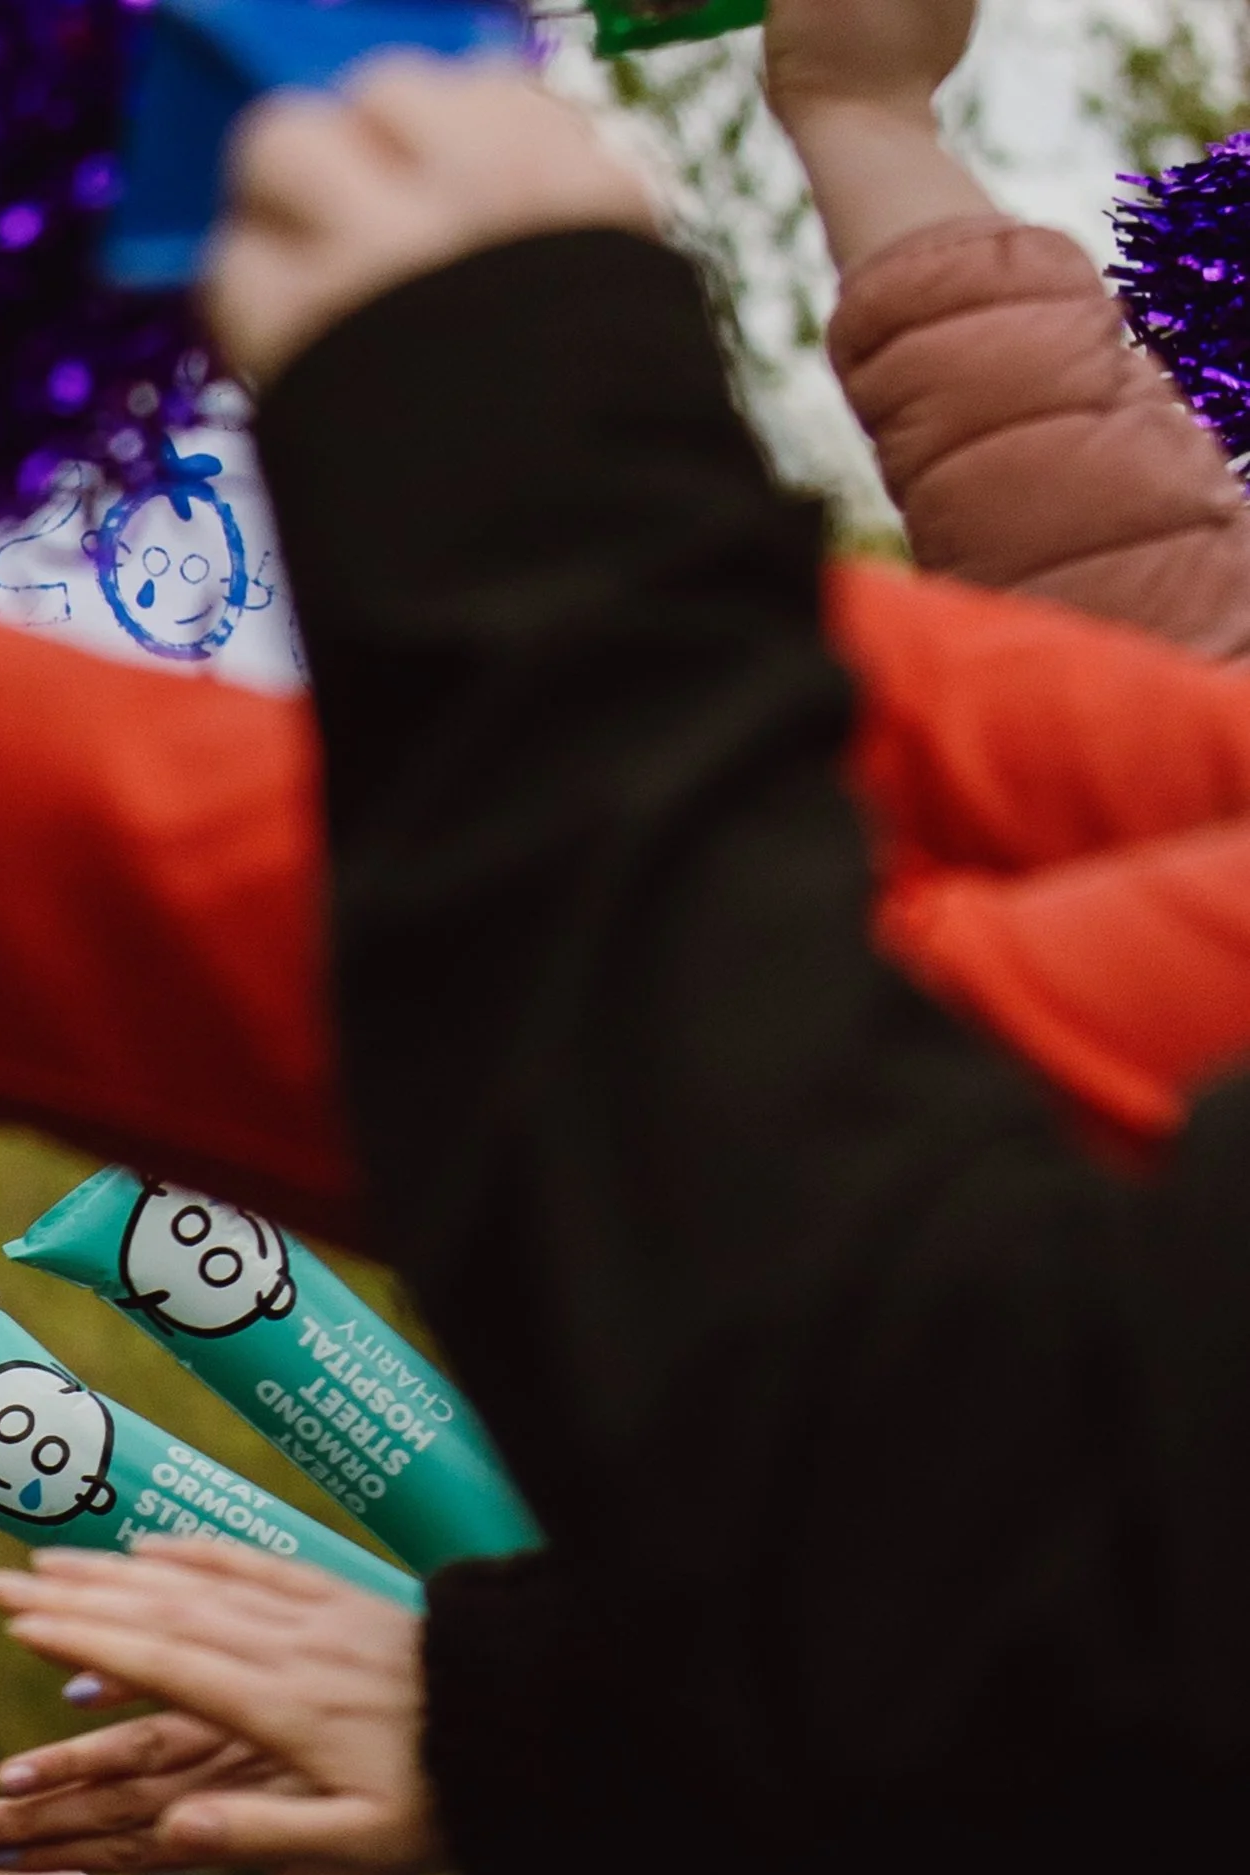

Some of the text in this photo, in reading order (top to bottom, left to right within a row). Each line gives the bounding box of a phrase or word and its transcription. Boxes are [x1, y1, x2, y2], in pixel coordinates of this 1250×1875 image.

[296, 1315, 438, 1453] HOSPITAL
[334, 1319, 454, 1423] CHARITY
[255, 1379, 387, 1499] ORMOND
[273, 1432, 367, 1514] GREAT
[297, 1376, 411, 1476] STREET
[151, 1463, 299, 1555] ORMOND
[166, 1445, 275, 1510] GREAT
